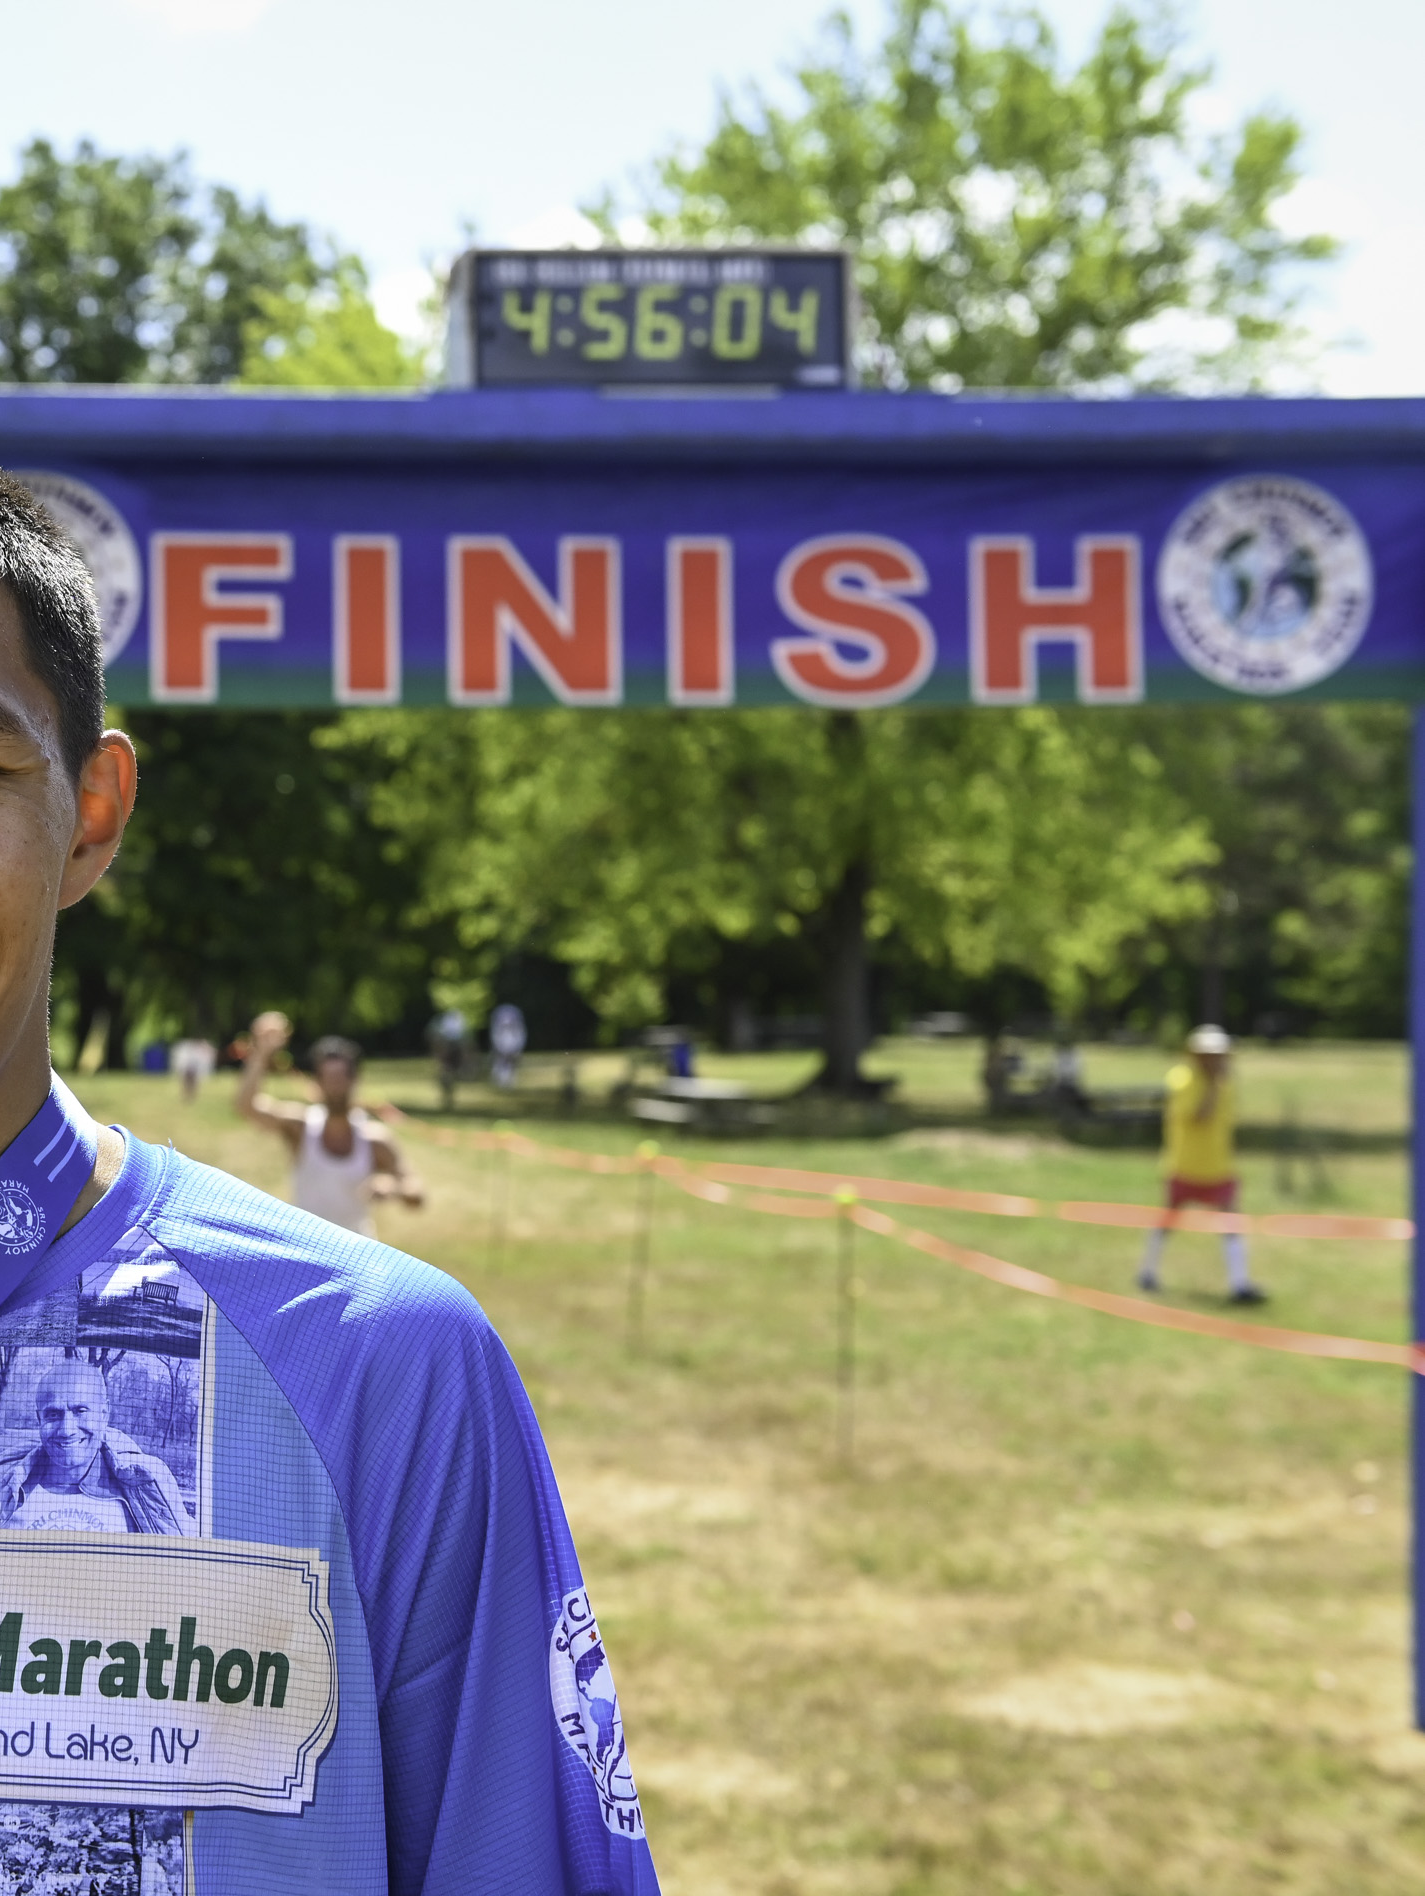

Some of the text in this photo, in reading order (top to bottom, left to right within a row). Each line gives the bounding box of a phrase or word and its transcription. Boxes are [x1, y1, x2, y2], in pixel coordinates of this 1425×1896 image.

[501, 282, 820, 361] 4:56:04
[149, 531, 1144, 708] FINISH
[5, 1206, 47, 1255] SRI CHINMOY
[45, 1721, 140, 1767] Lake,
[150, 1726, 200, 1765] NY
